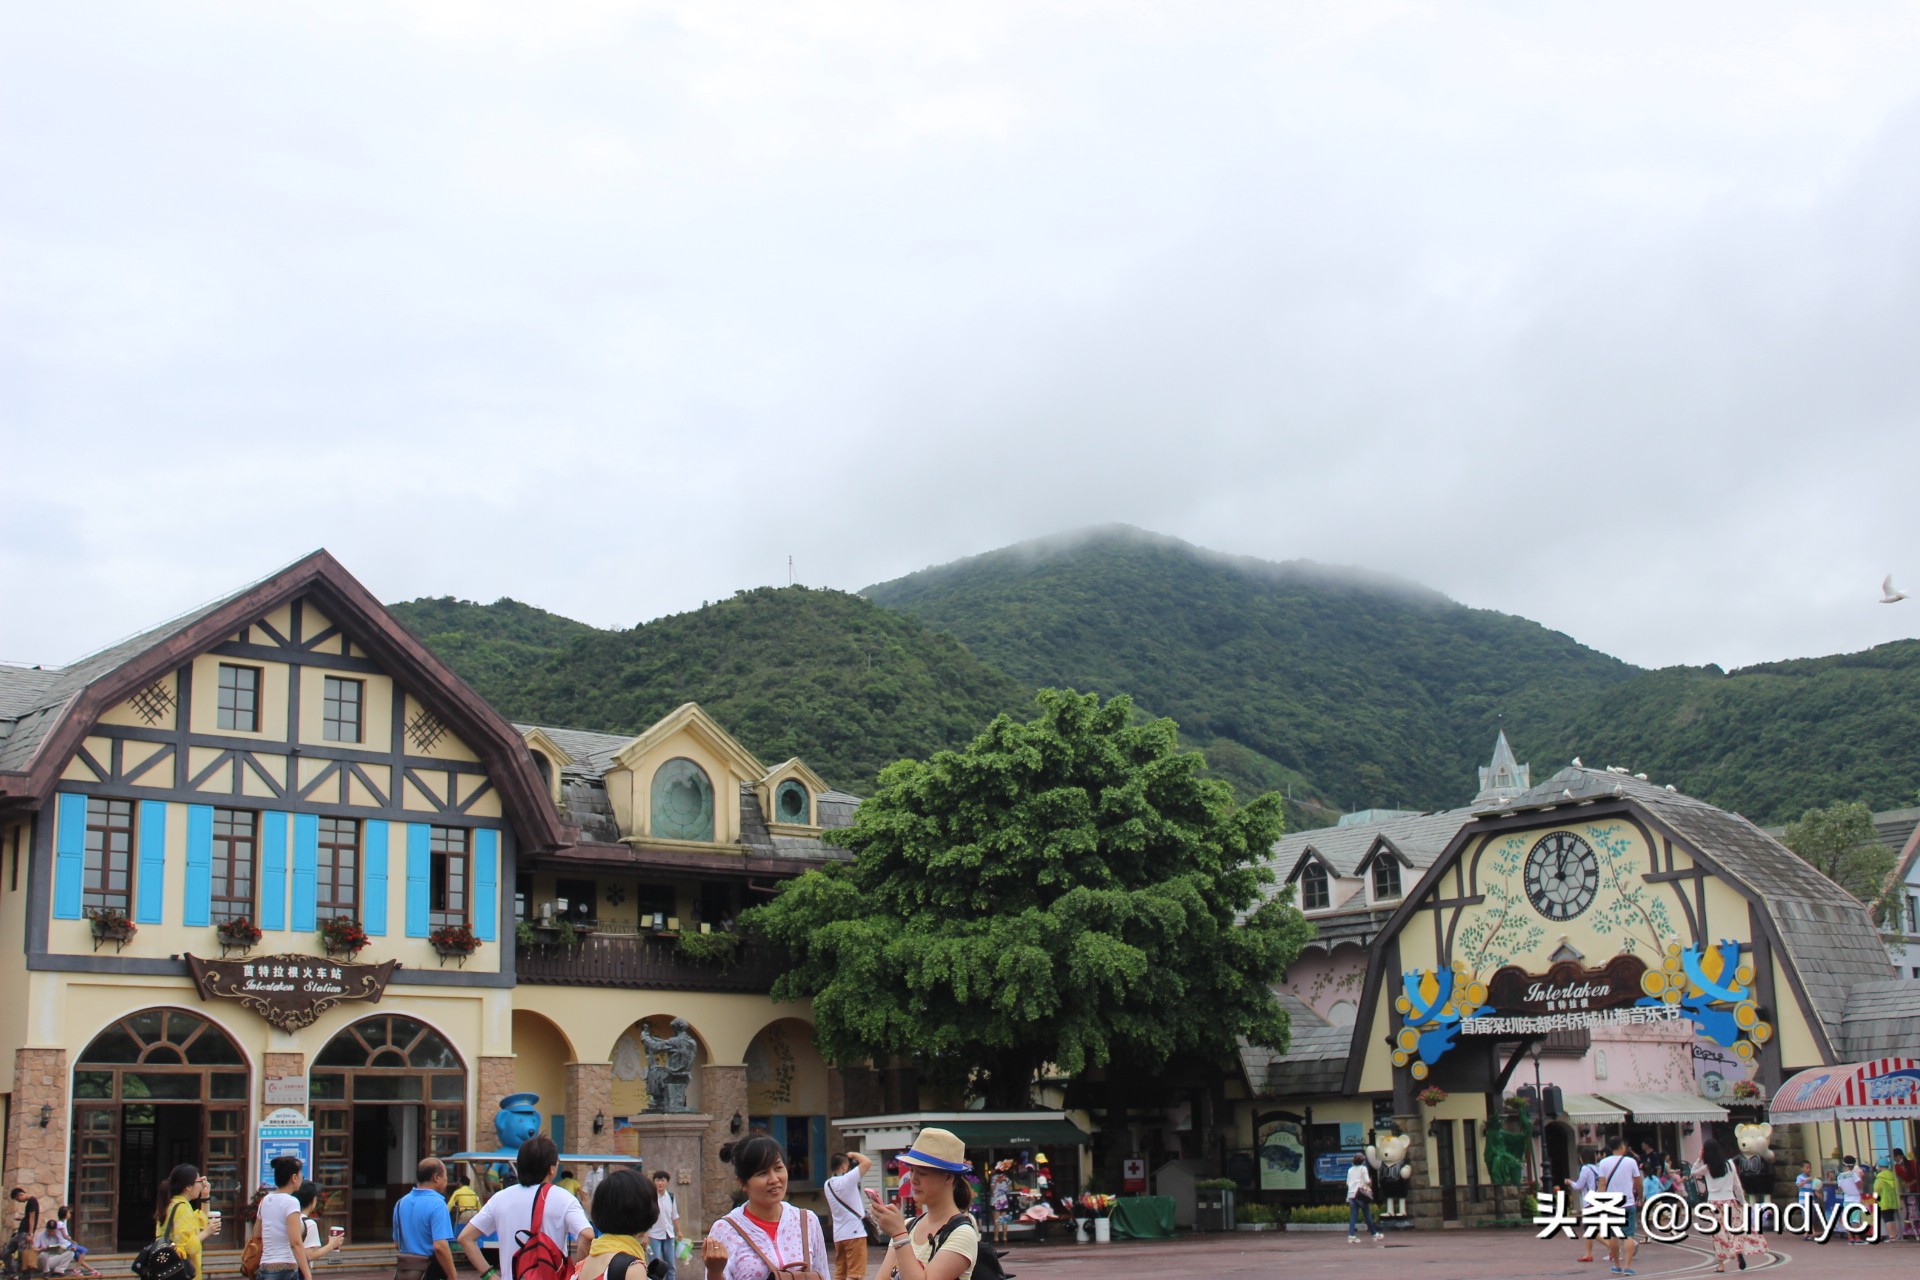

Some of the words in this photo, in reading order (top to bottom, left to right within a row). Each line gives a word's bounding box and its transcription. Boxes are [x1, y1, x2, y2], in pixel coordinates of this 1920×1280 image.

[243, 965, 342, 980] 茵特拉根火车站
[243, 979, 295, 992] Interlaken
[303, 980, 342, 993] Station
[1523, 982, 1611, 1002] Interlaken
[1546, 998, 1589, 1011] 茵特拉根
[1460, 1004, 1682, 1035] 首届深圳东部华侨城山海音乐节
